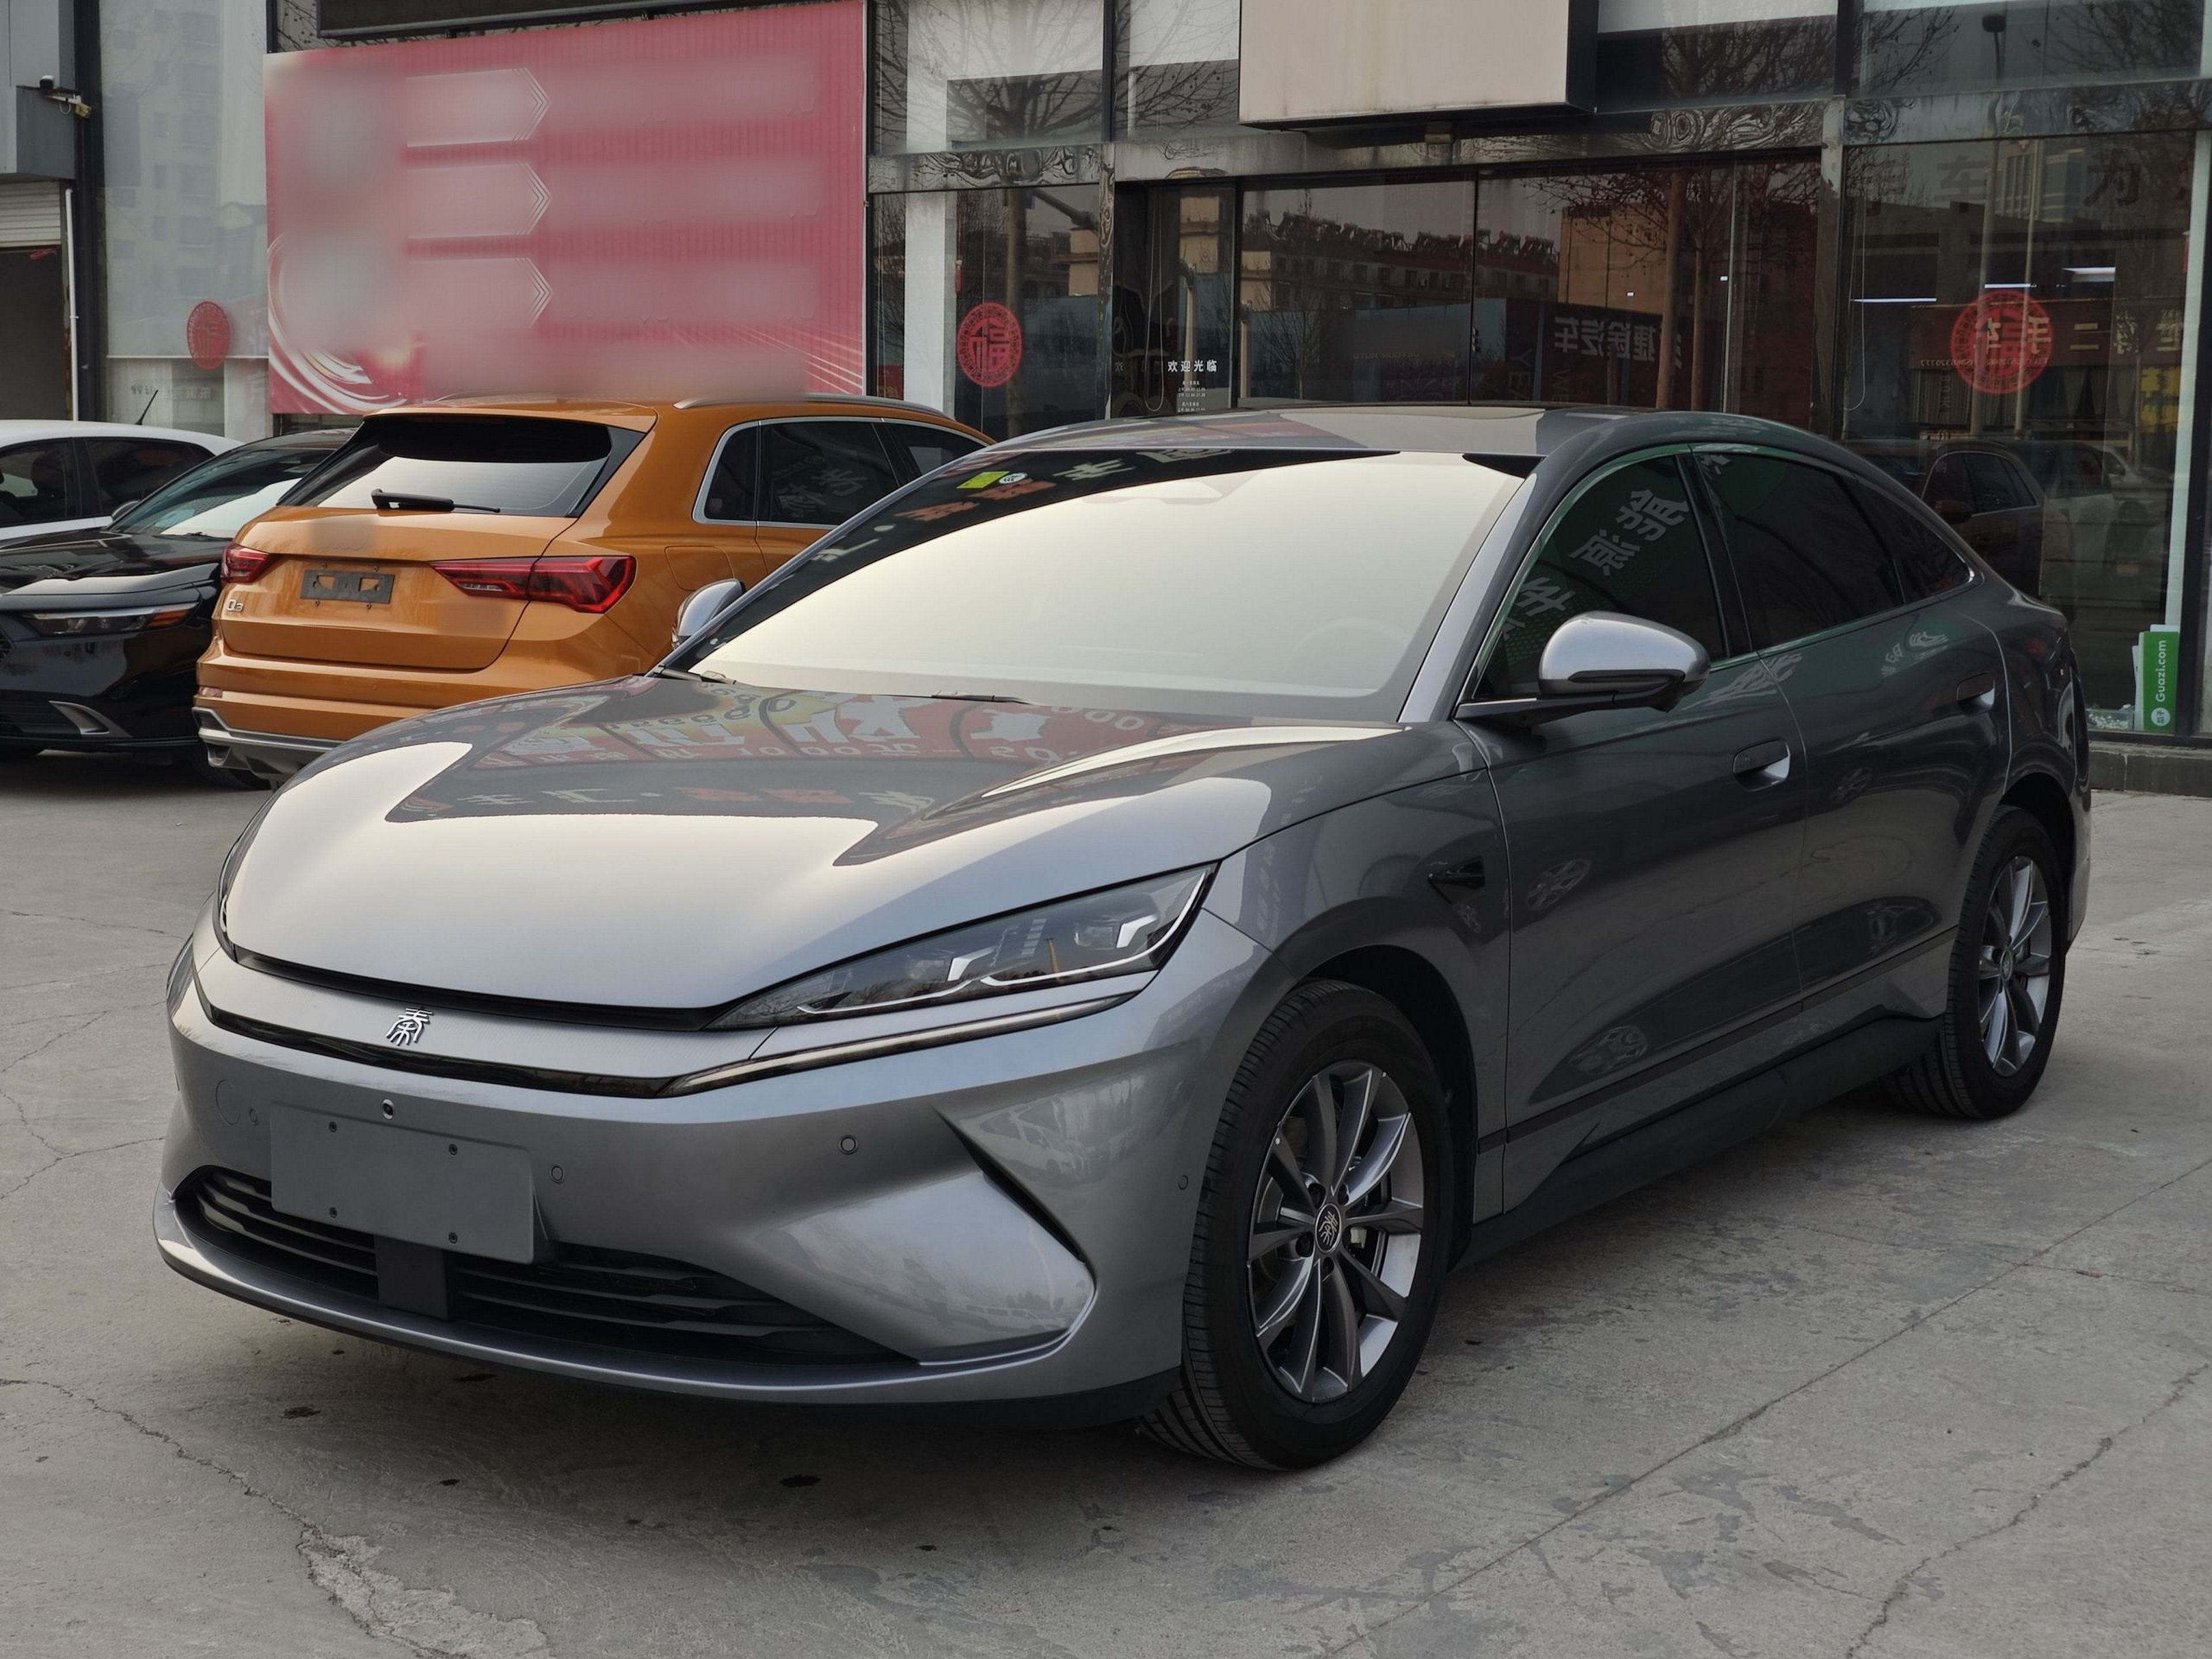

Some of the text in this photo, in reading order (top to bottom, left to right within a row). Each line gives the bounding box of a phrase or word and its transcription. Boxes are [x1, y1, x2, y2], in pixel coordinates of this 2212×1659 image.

[1168, 359, 1217, 373] 欢迎光临
[227, 599, 243, 612] Q3
[2156, 640, 2166, 702] Guazi.com
